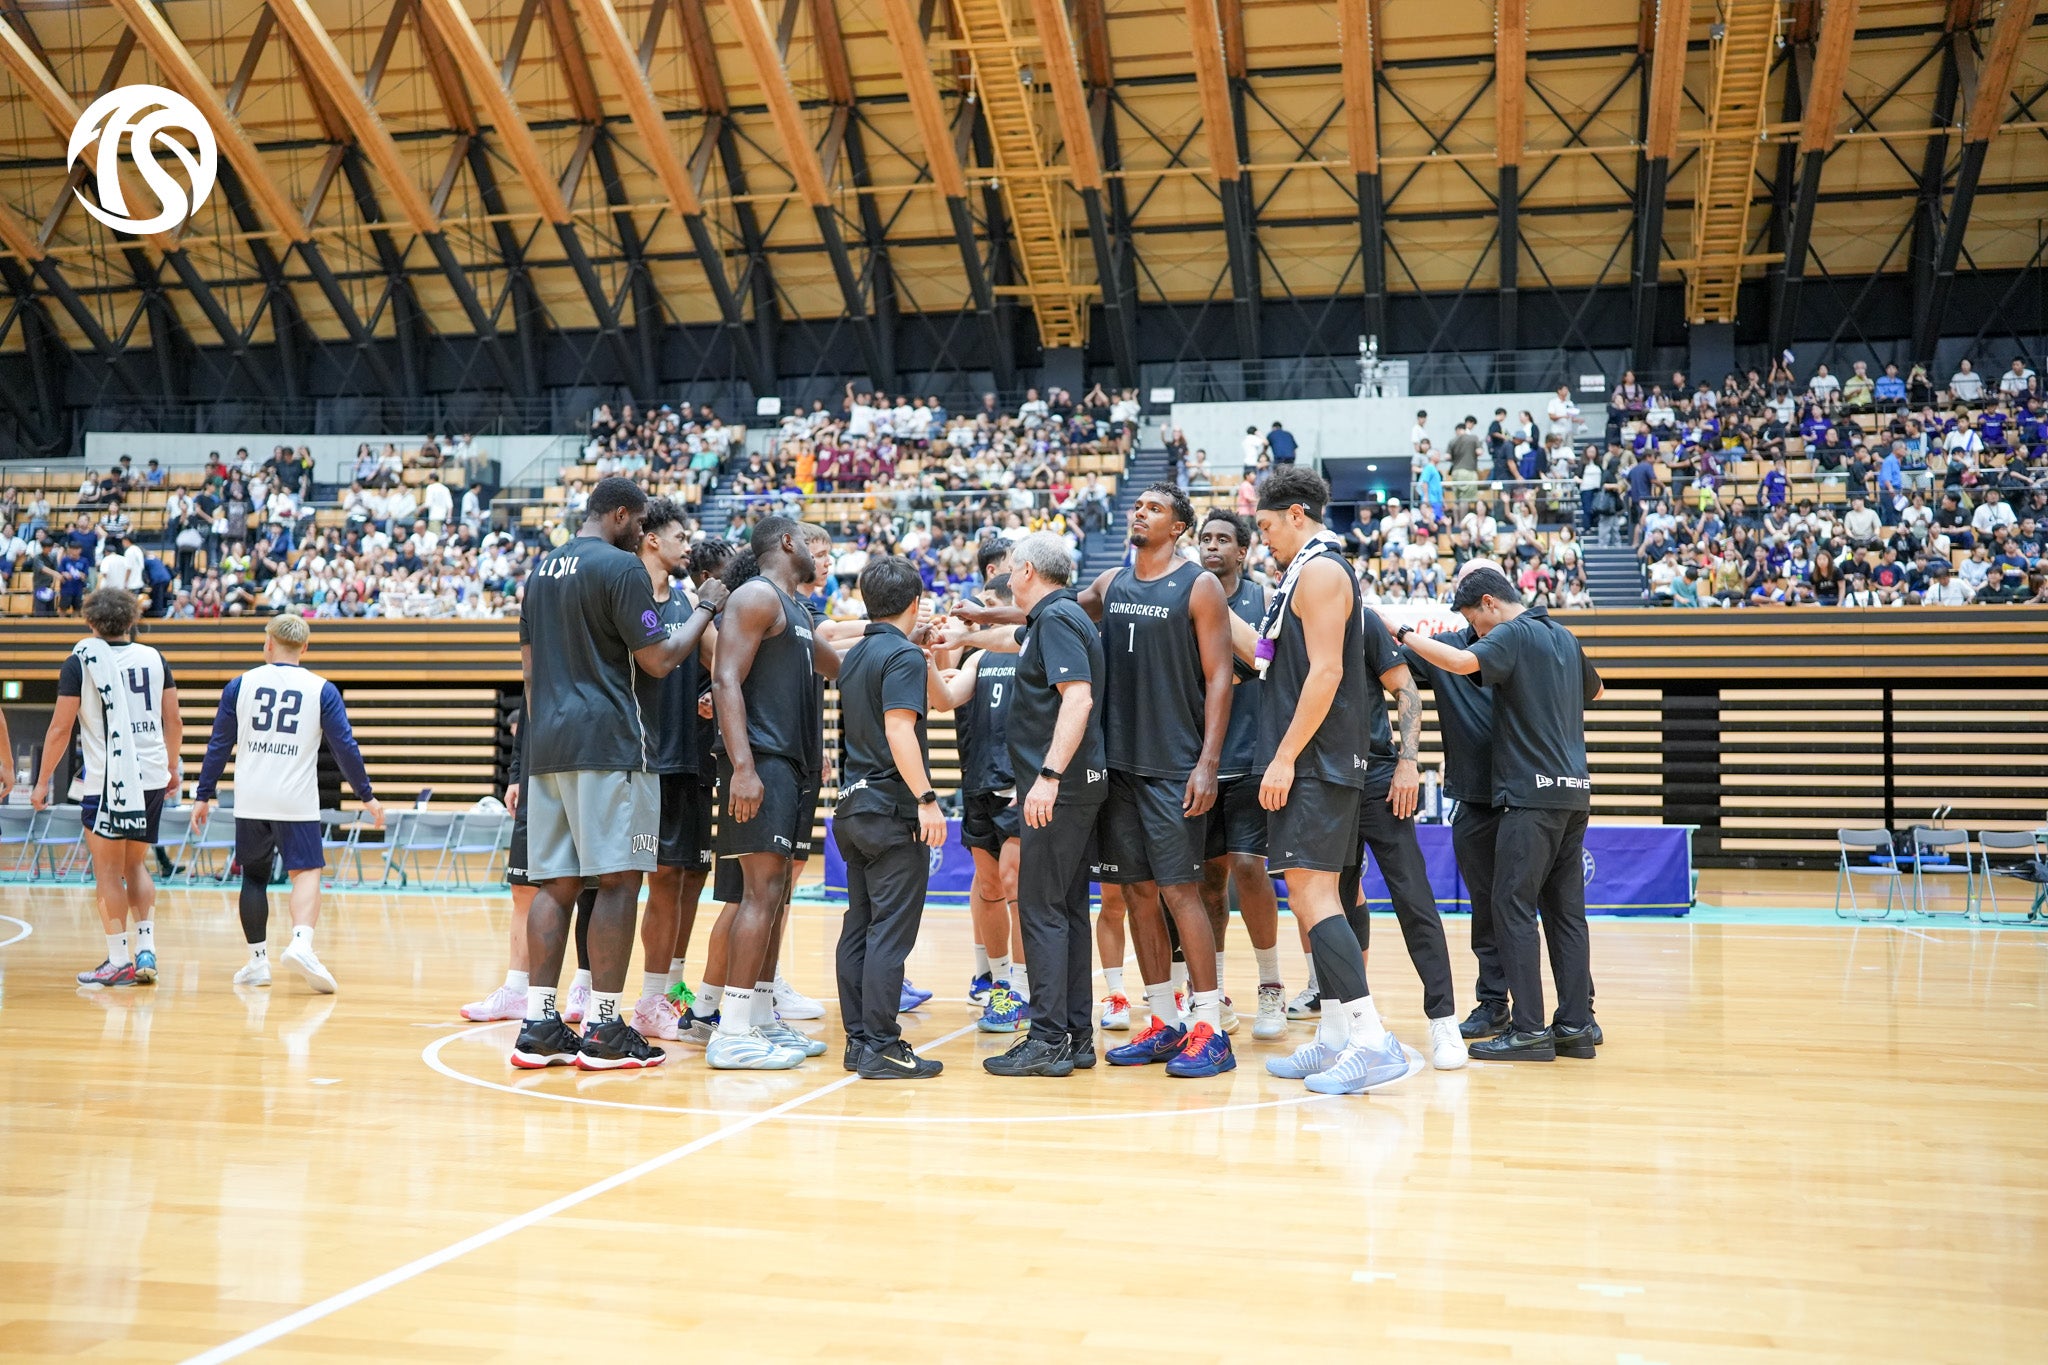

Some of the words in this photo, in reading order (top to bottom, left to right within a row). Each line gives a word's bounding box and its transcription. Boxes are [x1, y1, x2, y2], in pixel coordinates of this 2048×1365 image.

[539, 556, 579, 579] LIXIL
[1109, 602, 1170, 619] SUNROCKERS
[1127, 622, 1136, 653] 1
[990, 683, 1003, 708] 9
[252, 686, 303, 734] 32
[247, 741, 299, 756] YAMAUCHI
